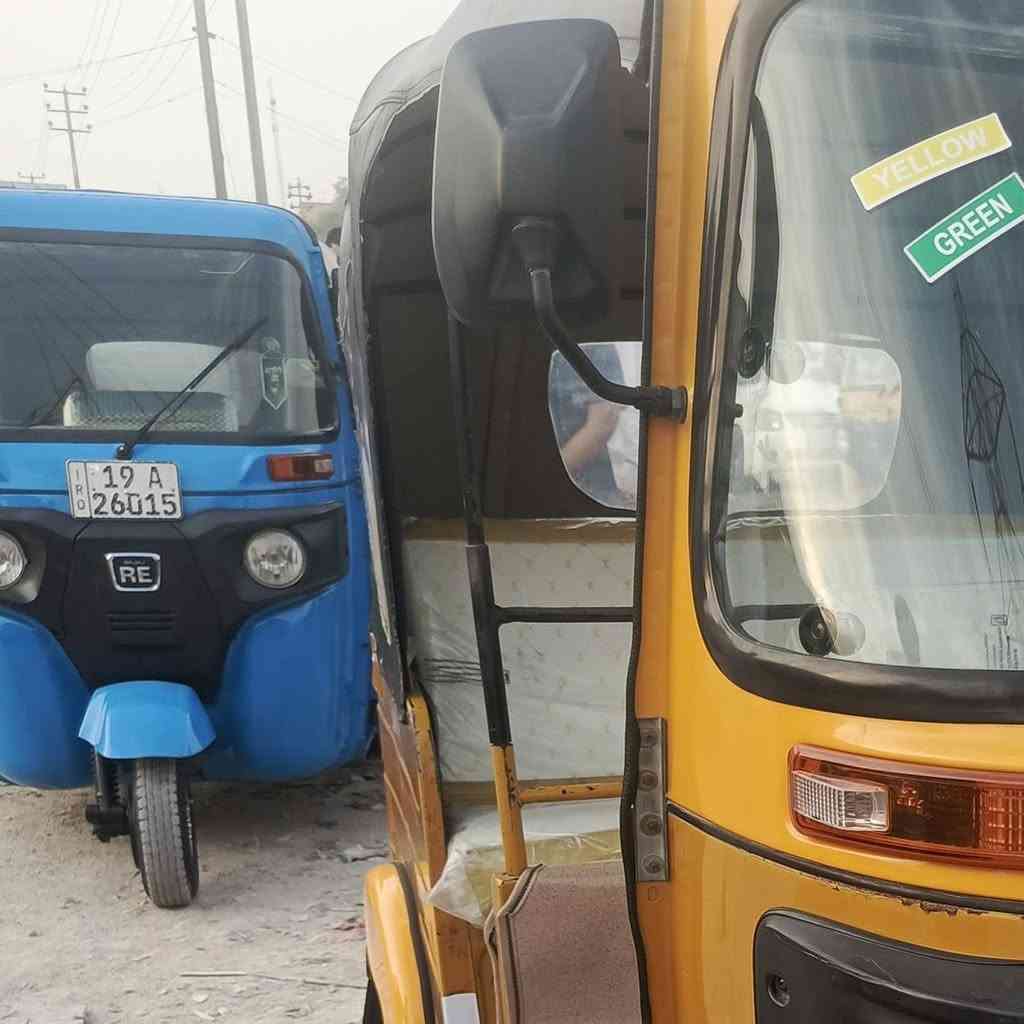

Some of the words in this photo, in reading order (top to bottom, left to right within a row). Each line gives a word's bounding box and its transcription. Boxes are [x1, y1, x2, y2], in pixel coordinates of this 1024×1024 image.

[871, 127, 988, 187] YELLOW
[933, 193, 1014, 256] GREEN
[103, 465, 135, 488] 19
[149, 466, 163, 488] A
[92, 492, 177, 515] 26015
[119, 566, 153, 583] RE
